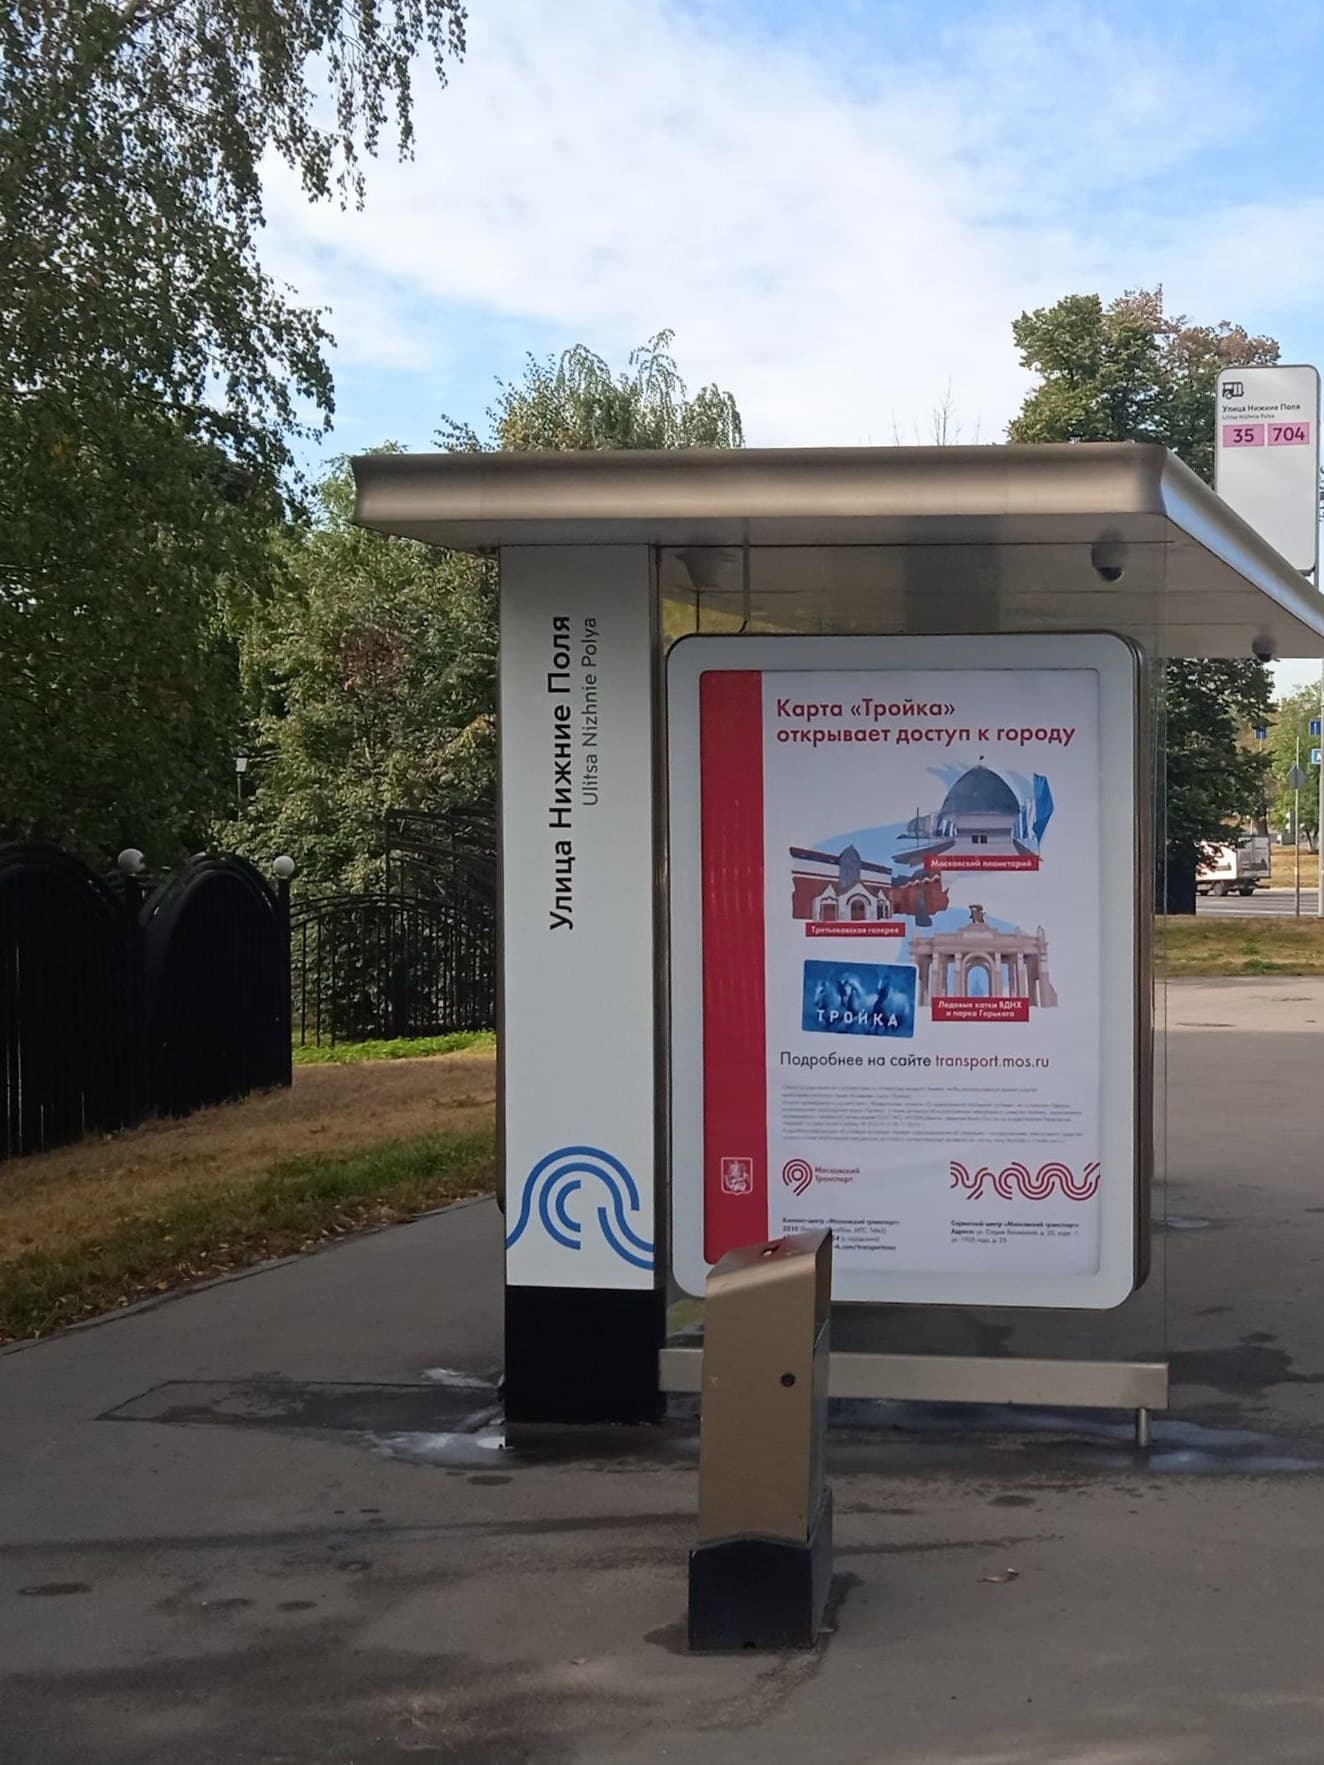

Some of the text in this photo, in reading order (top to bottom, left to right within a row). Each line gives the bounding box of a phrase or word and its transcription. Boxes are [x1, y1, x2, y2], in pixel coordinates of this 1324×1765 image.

[1222, 404, 1246, 413] Улица
[1248, 404, 1278, 412] Нижние
[1233, 428, 1254, 443] 35
[1272, 427, 1305, 442] 704
[581, 617, 599, 807] Ulitsa Nizhnie Polya
[776, 697, 955, 722] Карта «Тройка»
[776, 726, 1076, 747] открывает доступ к городу
[547, 615, 576, 931] Улица Нижние Поля
[816, 1008, 898, 1027] ТРОЙКА
[779, 1051, 864, 1070] Подробнее
[867, 1056, 886, 1067] на
[890, 1053, 932, 1067] сайте
